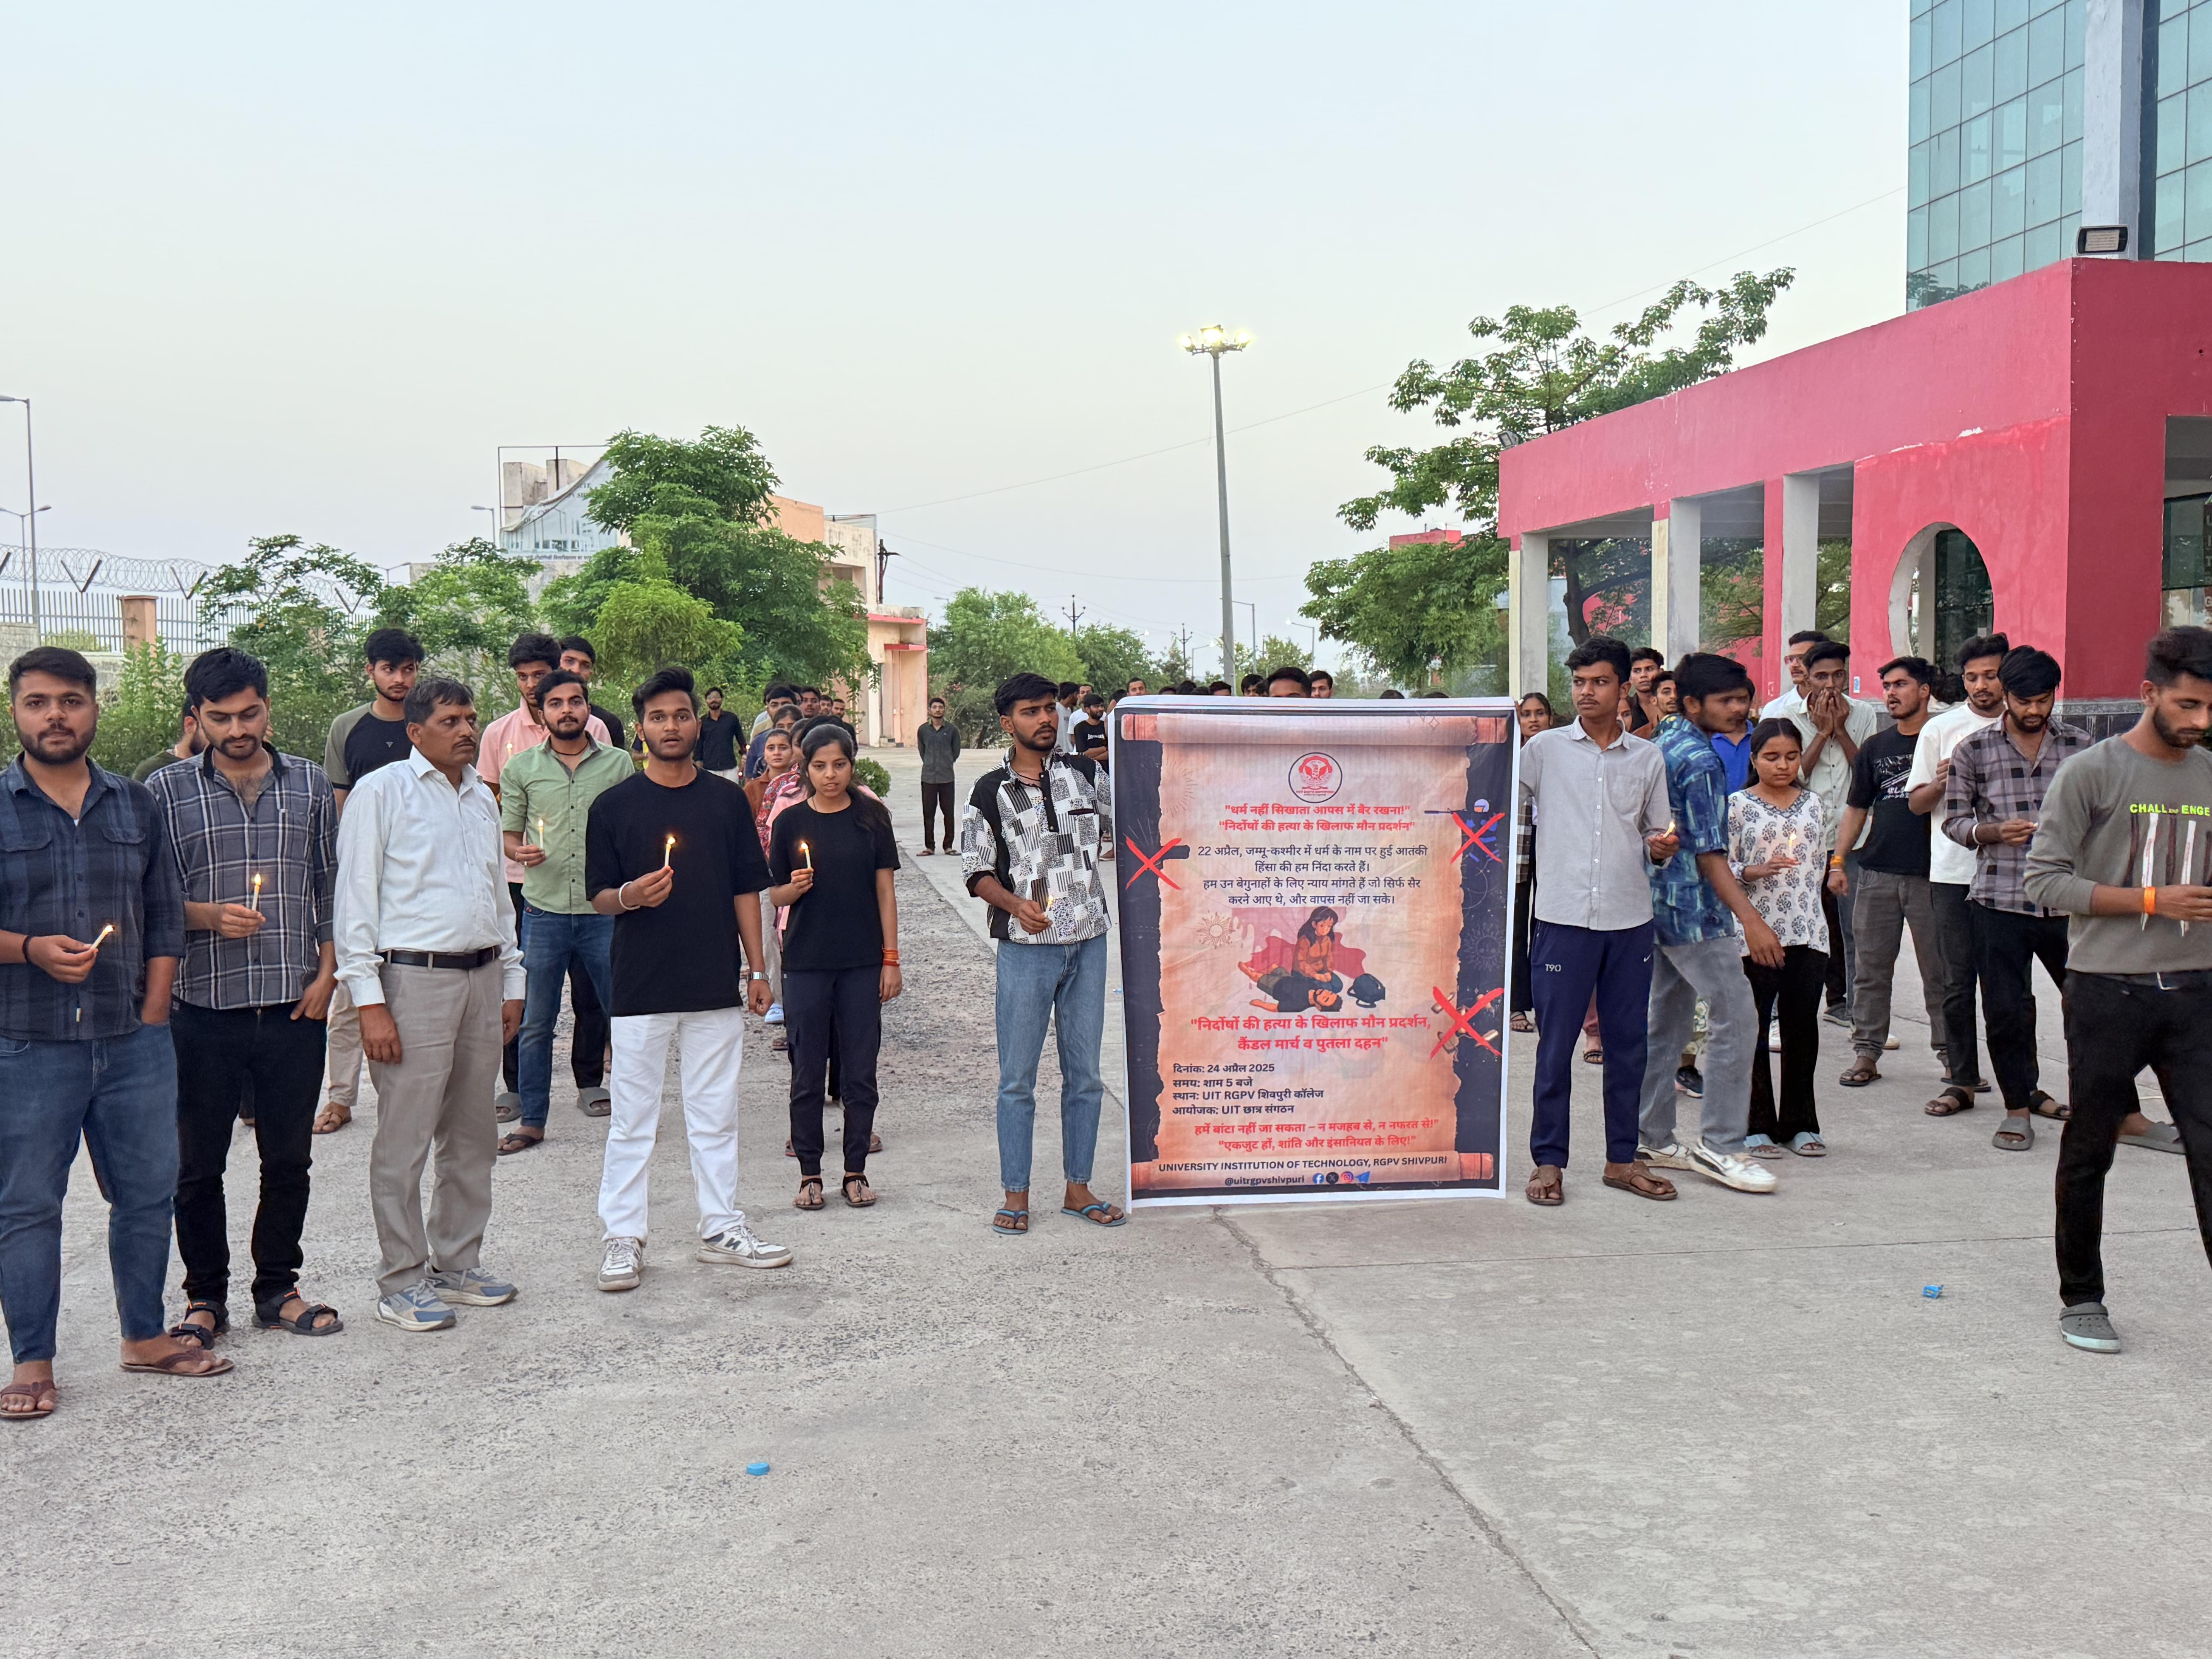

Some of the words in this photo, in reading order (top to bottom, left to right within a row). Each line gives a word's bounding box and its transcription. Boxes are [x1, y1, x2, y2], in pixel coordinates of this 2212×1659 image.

[1225, 803, 1248, 814] "धर्म
[1250, 803, 1269, 816] नहीं
[1272, 803, 1310, 814] सिखाता
[1346, 803, 1355, 814] में
[1358, 803, 1371, 814] बैर
[1374, 805, 1410, 815] रखना!"
[2130, 804, 2167, 813] CHALL
[2181, 805, 2210, 816] ENGE
[1219, 819, 1259, 831] "निर्दोषों
[1261, 819, 1276, 830] की
[1278, 822, 1301, 832] हत्या
[1303, 819, 1314, 830] के
[1316, 819, 1354, 830] खिलाफ
[1357, 819, 1376, 830] मौन
[1378, 819, 1415, 831] प्रदर्शन"
[1198, 846, 1211, 855] 22
[1214, 844, 1242, 857] अप्रैल,
[1245, 844, 1302, 859] जम्मू-कश्मीर
[1315, 844, 1330, 855] धर्म
[1332, 844, 1342, 855] के
[1379, 844, 1393, 859] हुई
[1396, 845, 1428, 855] आतंकी
[1255, 860, 1277, 872] हिंसा
[1279, 860, 1292, 872] की
[1295, 863, 1309, 873] हम
[1312, 860, 1332, 872] निंदा
[1334, 860, 1356, 872] करते
[1204, 880, 1218, 890] हम
[1220, 880, 1234, 888] उन
[1237, 877, 1271, 891] बेगुनाहों
[1274, 877, 1283, 888] के
[1286, 877, 1304, 890] लिए
[1307, 879, 1329, 888] न्याय
[1331, 877, 1356, 888] मांगते
[1368, 877, 1381, 888] जो
[1384, 877, 1405, 888] सिर्फ
[1229, 893, 1250, 905] करने
[1253, 896, 1273, 906] आए
[1275, 893, 1286, 906] थे,
[1289, 893, 1307, 904] और
[1310, 896, 1335, 904] वापस
[1338, 893, 1355, 905] नहीं
[1358, 896, 1370, 904] जा
[1373, 893, 1394, 904] सके।
[1190, 1016, 1240, 1031] "निर्दोषों
[1243, 1016, 1260, 1029] की
[1263, 1019, 1292, 1031] हत्या
[1295, 1015, 1308, 1029] के
[1311, 1015, 1358, 1029] खिलाफ
[1361, 1014, 1386, 1028] मौन
[1389, 1013, 1431, 1030] प्रदर्शन,
[1238, 1036, 1271, 1050] कैंडल
[1275, 1035, 1300, 1049] मार्च
[1303, 1039, 1313, 1049] व
[1316, 1038, 1352, 1053] पुतला
[1355, 1037, 1388, 1050] दहन"
[1173, 1063, 1205, 1073] दिनांक:
[1223, 1063, 1247, 1073] अप्रैल
[1249, 1064, 1274, 1072] 2025
[1203, 1079, 1223, 1087] शाम
[1236, 1076, 1253, 1087] बजे
[1172, 1092, 1199, 1101] स्थान:
[1202, 1091, 1221, 1100] UIT
[1224, 1091, 1255, 1100] RGPV
[1258, 1089, 1291, 1101] शिवपुरी
[1294, 1088, 1324, 1099] कॉलेज
[1172, 1104, 1218, 1115] आयोजक:
[1222, 1105, 1240, 1114] UIT
[1243, 1106, 1262, 1114] छात्र
[1265, 1103, 1295, 1114] संगठन
[1195, 1123, 1211, 1135] हमें
[1213, 1123, 1235, 1134] बांटा
[1238, 1121, 1256, 1135] नहीं
[1259, 1124, 1273, 1133] जा
[1275, 1124, 1306, 1132] सकता
[1318, 1123, 1326, 1132] न
[1328, 1122, 1361, 1132] मजहब
[1363, 1119, 1376, 1132] से,
[1389, 1121, 1419, 1130] नफरत
[1261, 1137, 1275, 1151] हों,
[1278, 1137, 1302, 1149] शांति
[1305, 1137, 1324, 1149] और
[1327, 1135, 1373, 1148] इंसानियत
[1374, 1135, 1385, 1146] के
[1159, 1163, 1218, 1171] UNIVERSITY
[1221, 1161, 1284, 1170] INSTITUTION
[1302, 1159, 1371, 1168] TECHNOLOGY,
[1374, 1158, 1399, 1166] RGPV
[1401, 1156, 1447, 1165] SHIVPURI
[1224, 1175, 1304, 1186] @uitrgpvshivpuri
